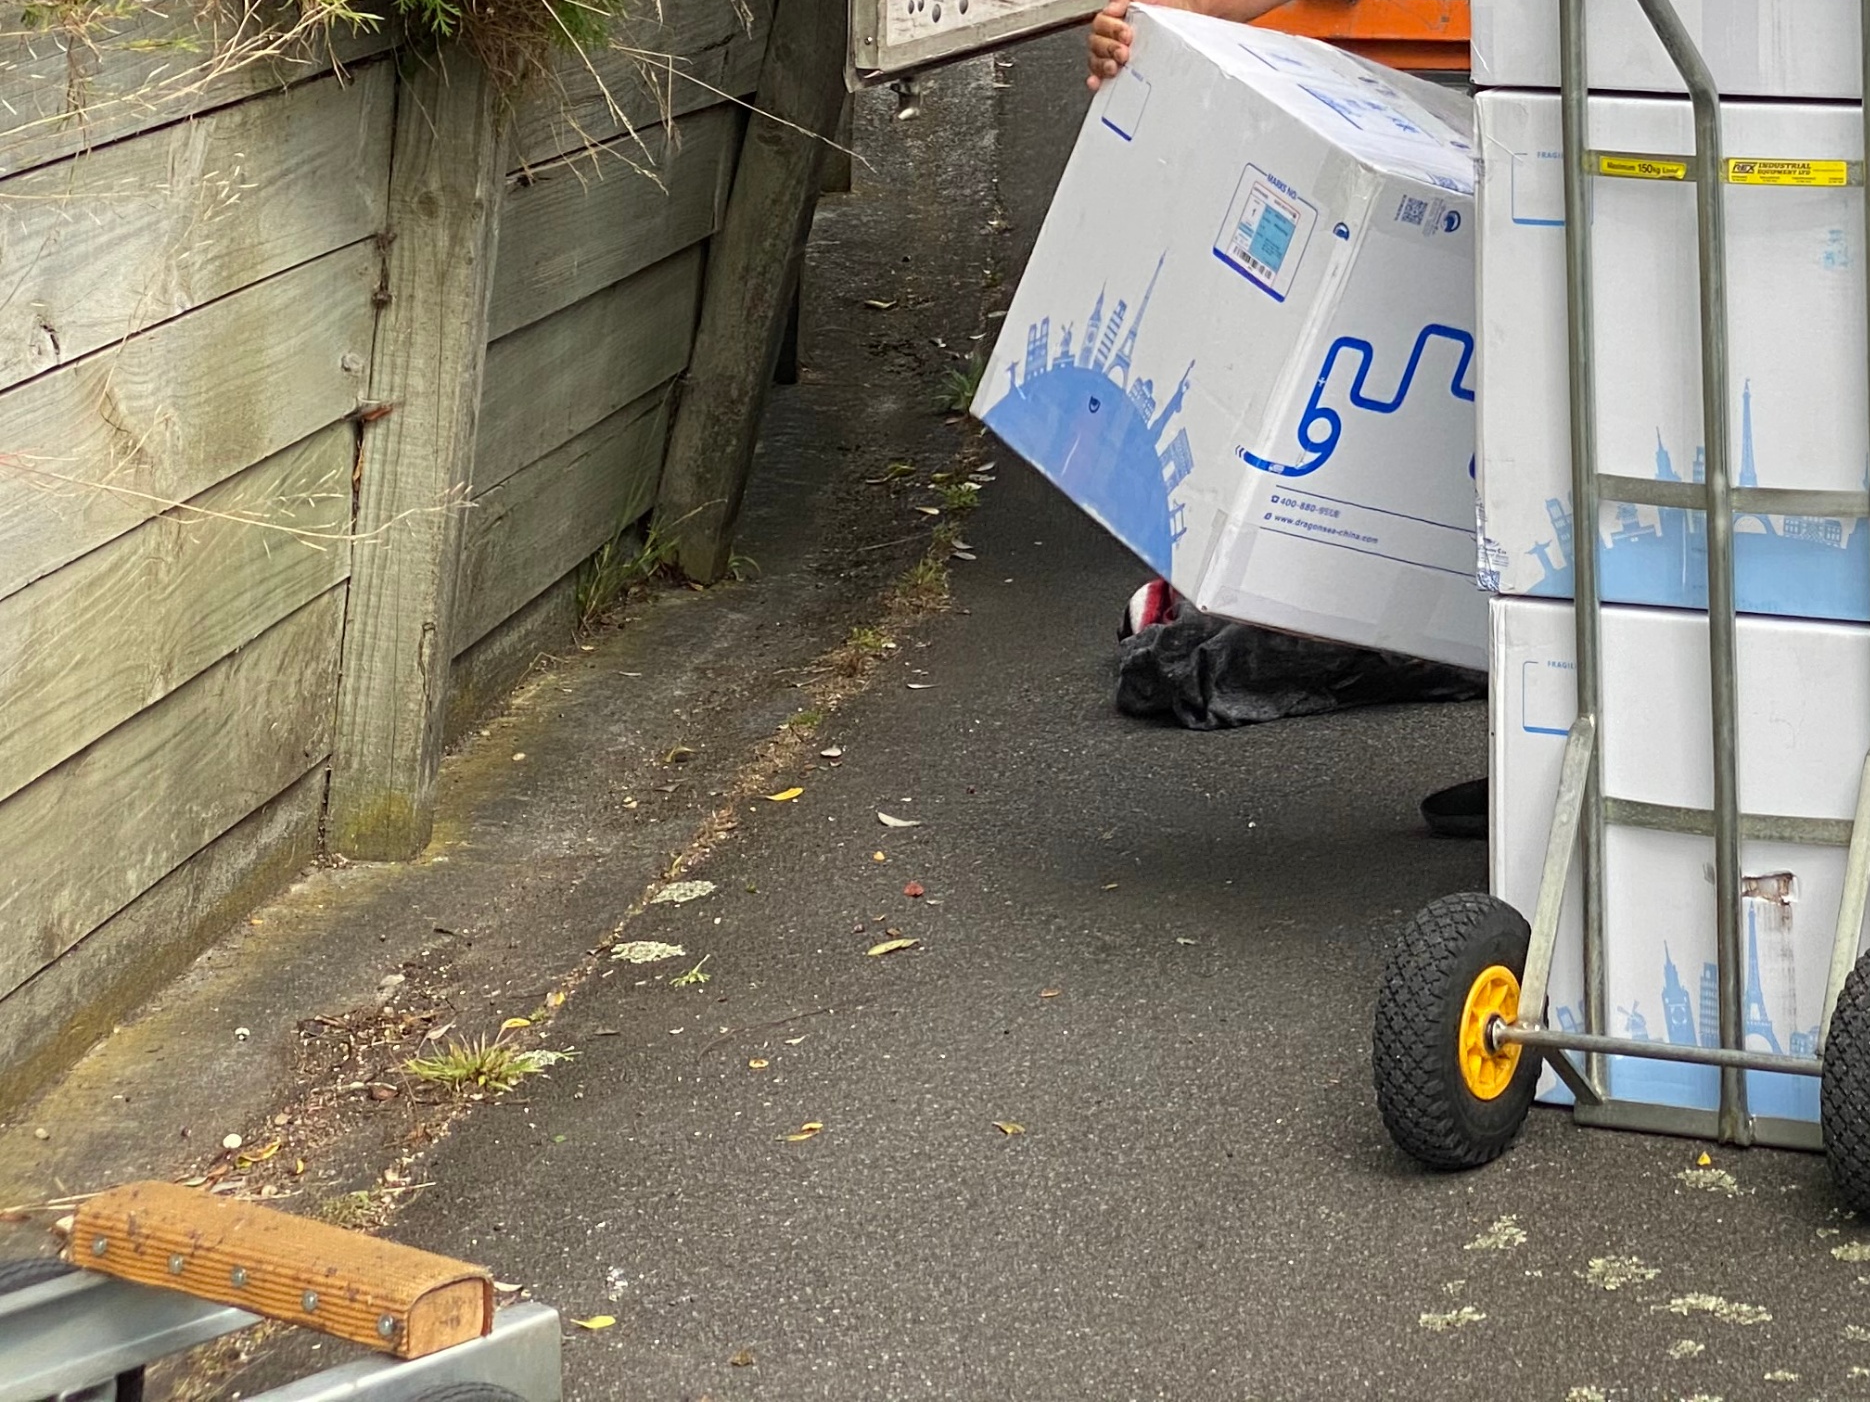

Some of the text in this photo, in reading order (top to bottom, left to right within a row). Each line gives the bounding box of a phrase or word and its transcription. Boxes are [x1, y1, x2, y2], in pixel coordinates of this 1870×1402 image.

[1758, 162, 1812, 170] INDUSTRIAL
[1267, 173, 1287, 193] MARKS
[1274, 514, 1379, 544] www.dragonsea-china.com
